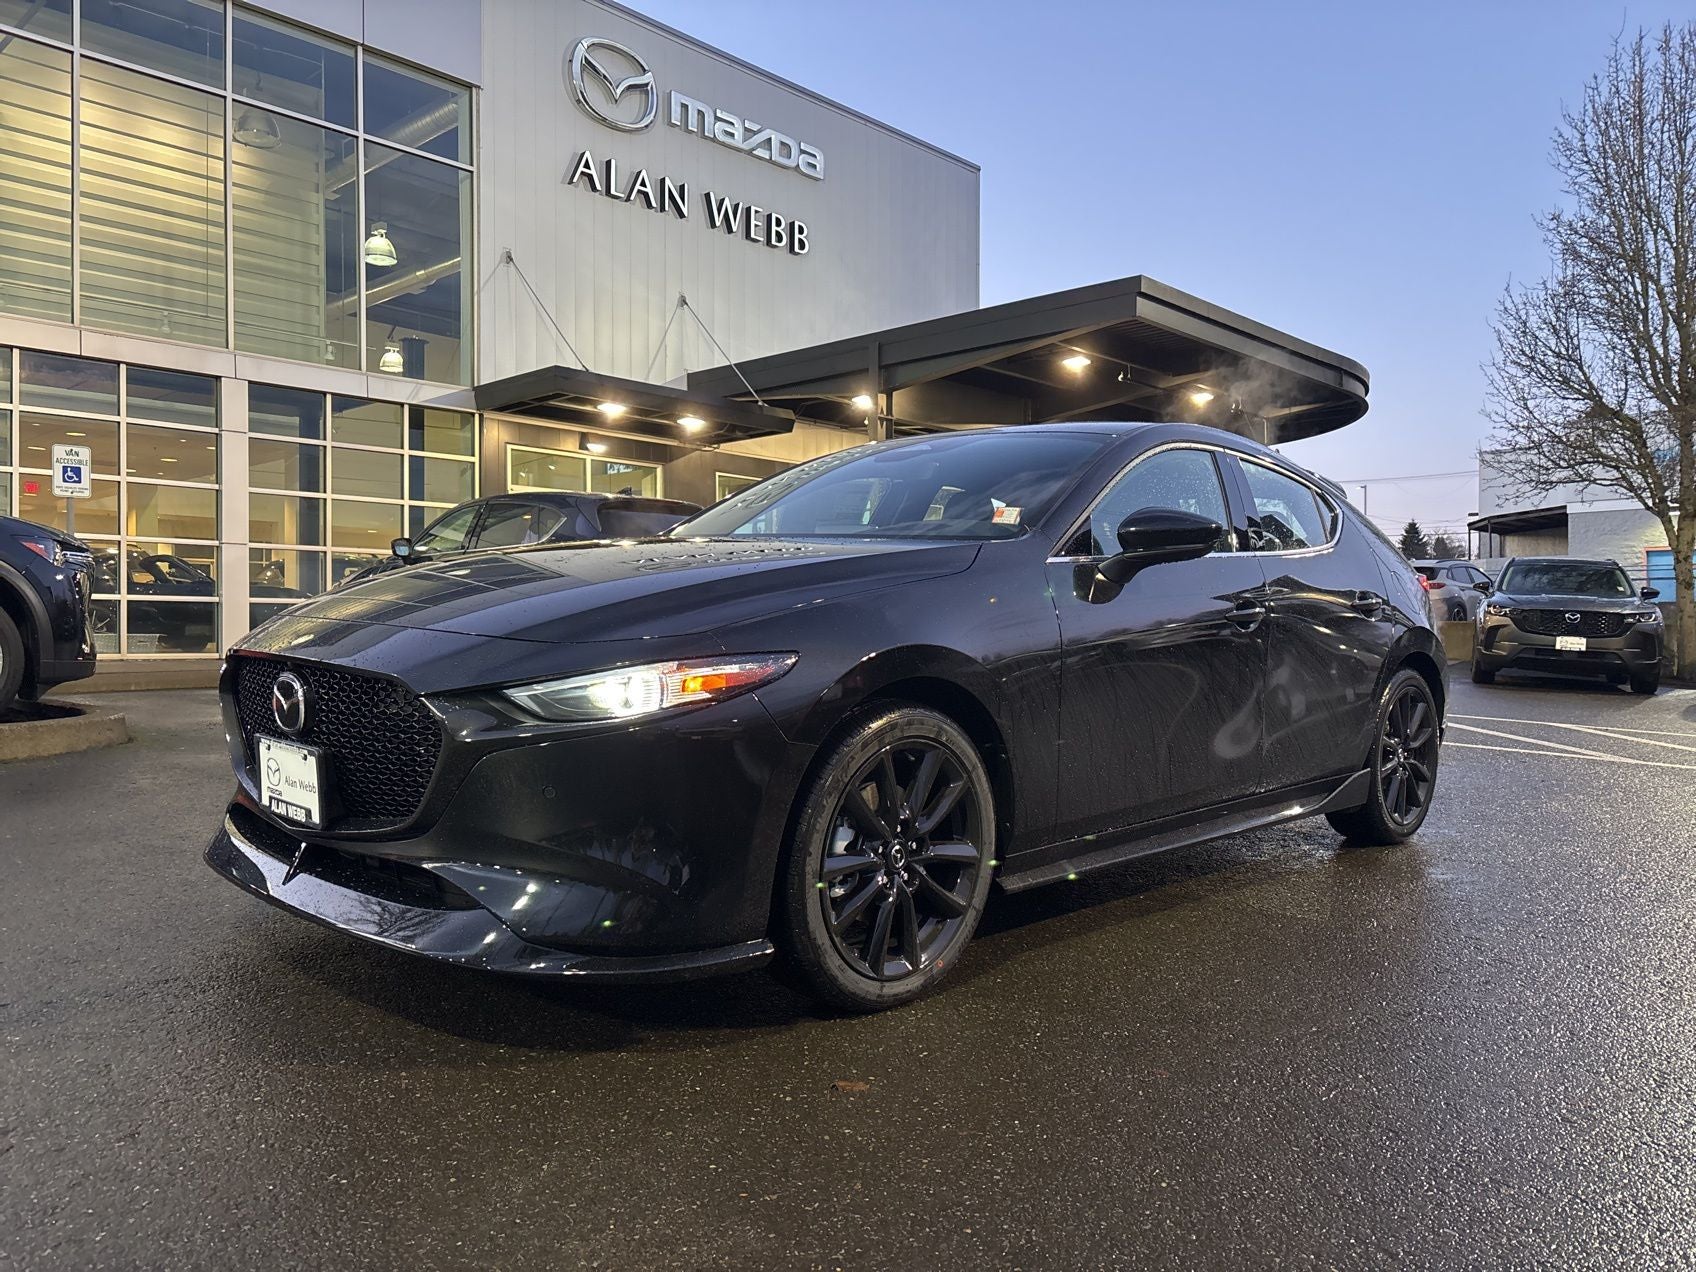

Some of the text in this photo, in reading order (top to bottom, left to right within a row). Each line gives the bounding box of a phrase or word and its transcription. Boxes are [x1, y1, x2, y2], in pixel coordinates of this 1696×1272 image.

[569, 150, 809, 255] ALAN WEBB
[56, 457, 88, 466] ACCESSIBLE
[65, 449, 79, 457] VAN
[284, 775, 317, 794] Alan Webb
[271, 798, 306, 822] ALAN WEBB
